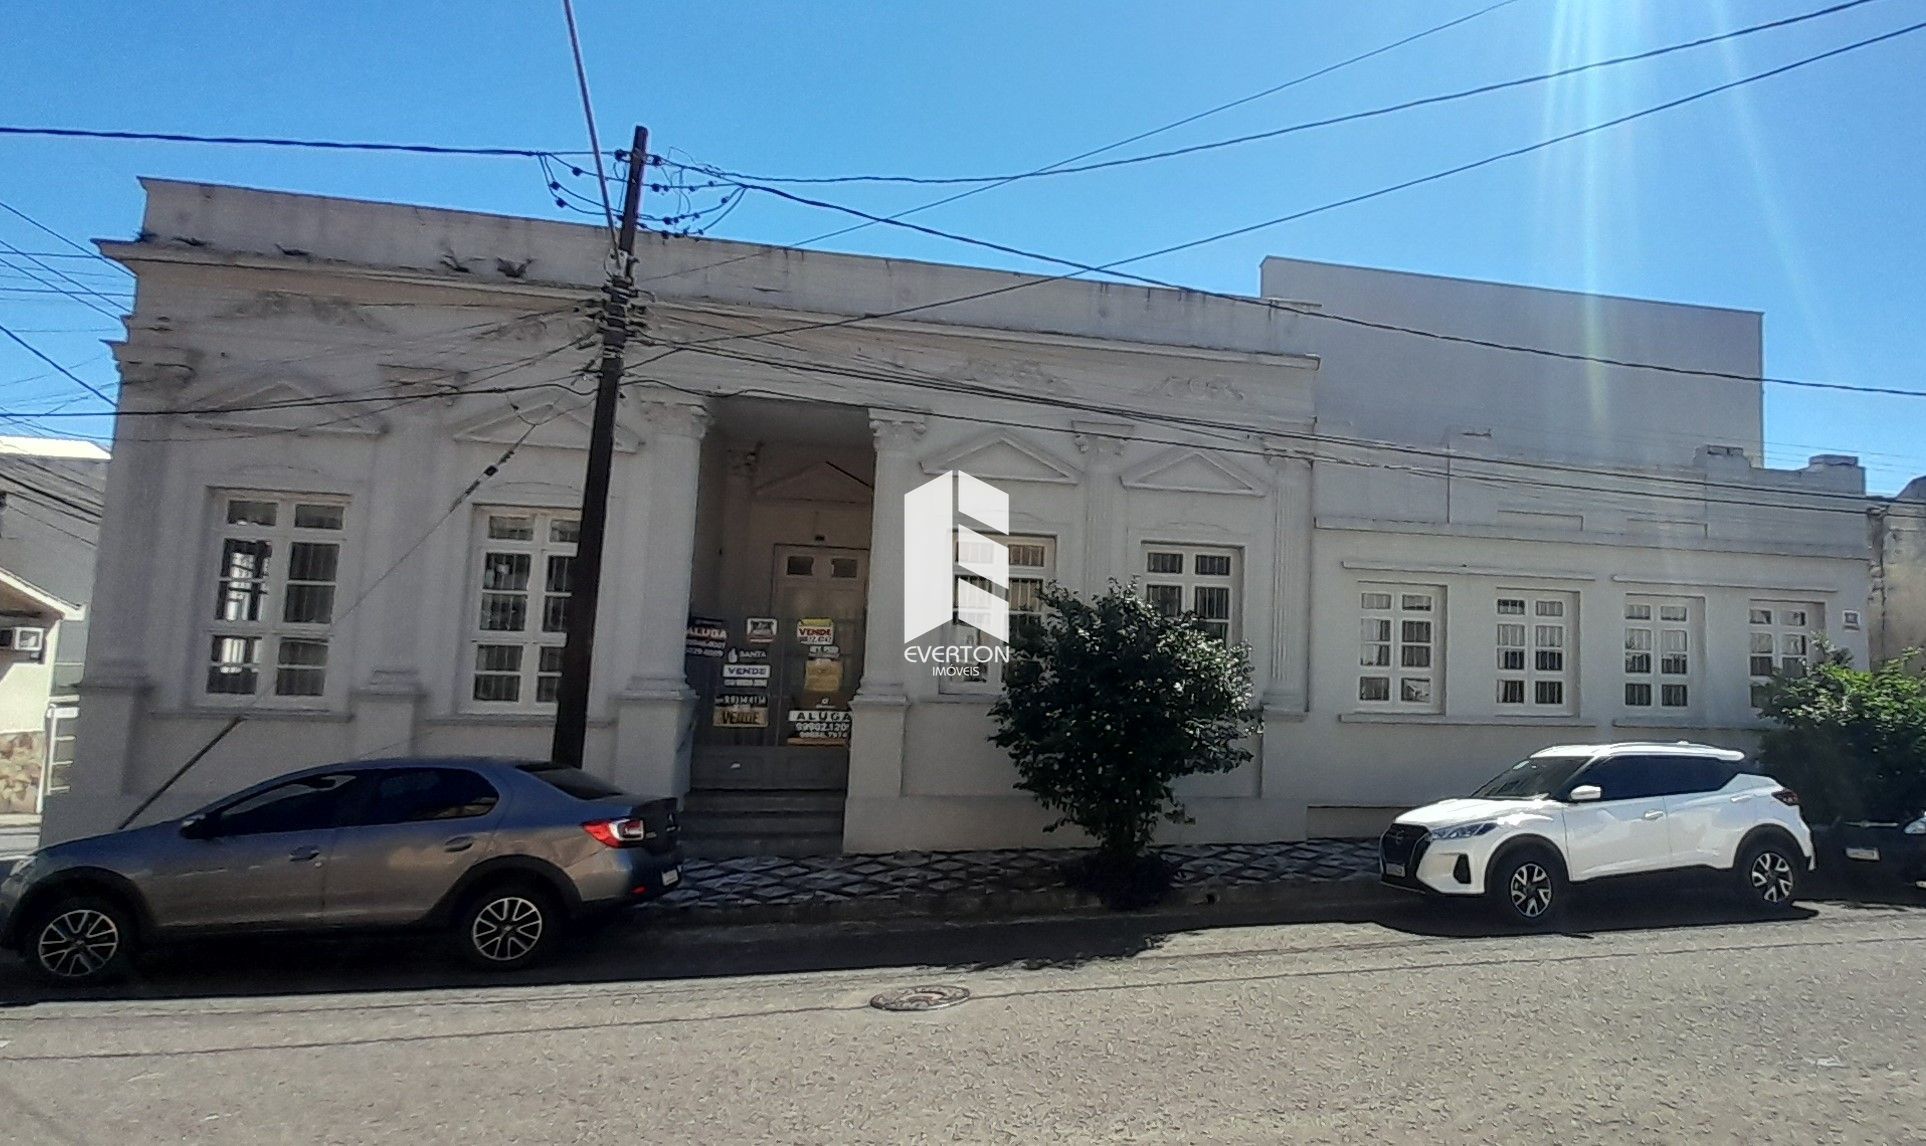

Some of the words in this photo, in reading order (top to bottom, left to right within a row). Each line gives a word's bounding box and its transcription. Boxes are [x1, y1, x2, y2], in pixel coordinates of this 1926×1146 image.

[740, 650, 767, 658] SANTA
[728, 667, 767, 675] VENDE
[797, 712, 851, 720] ALUGA
